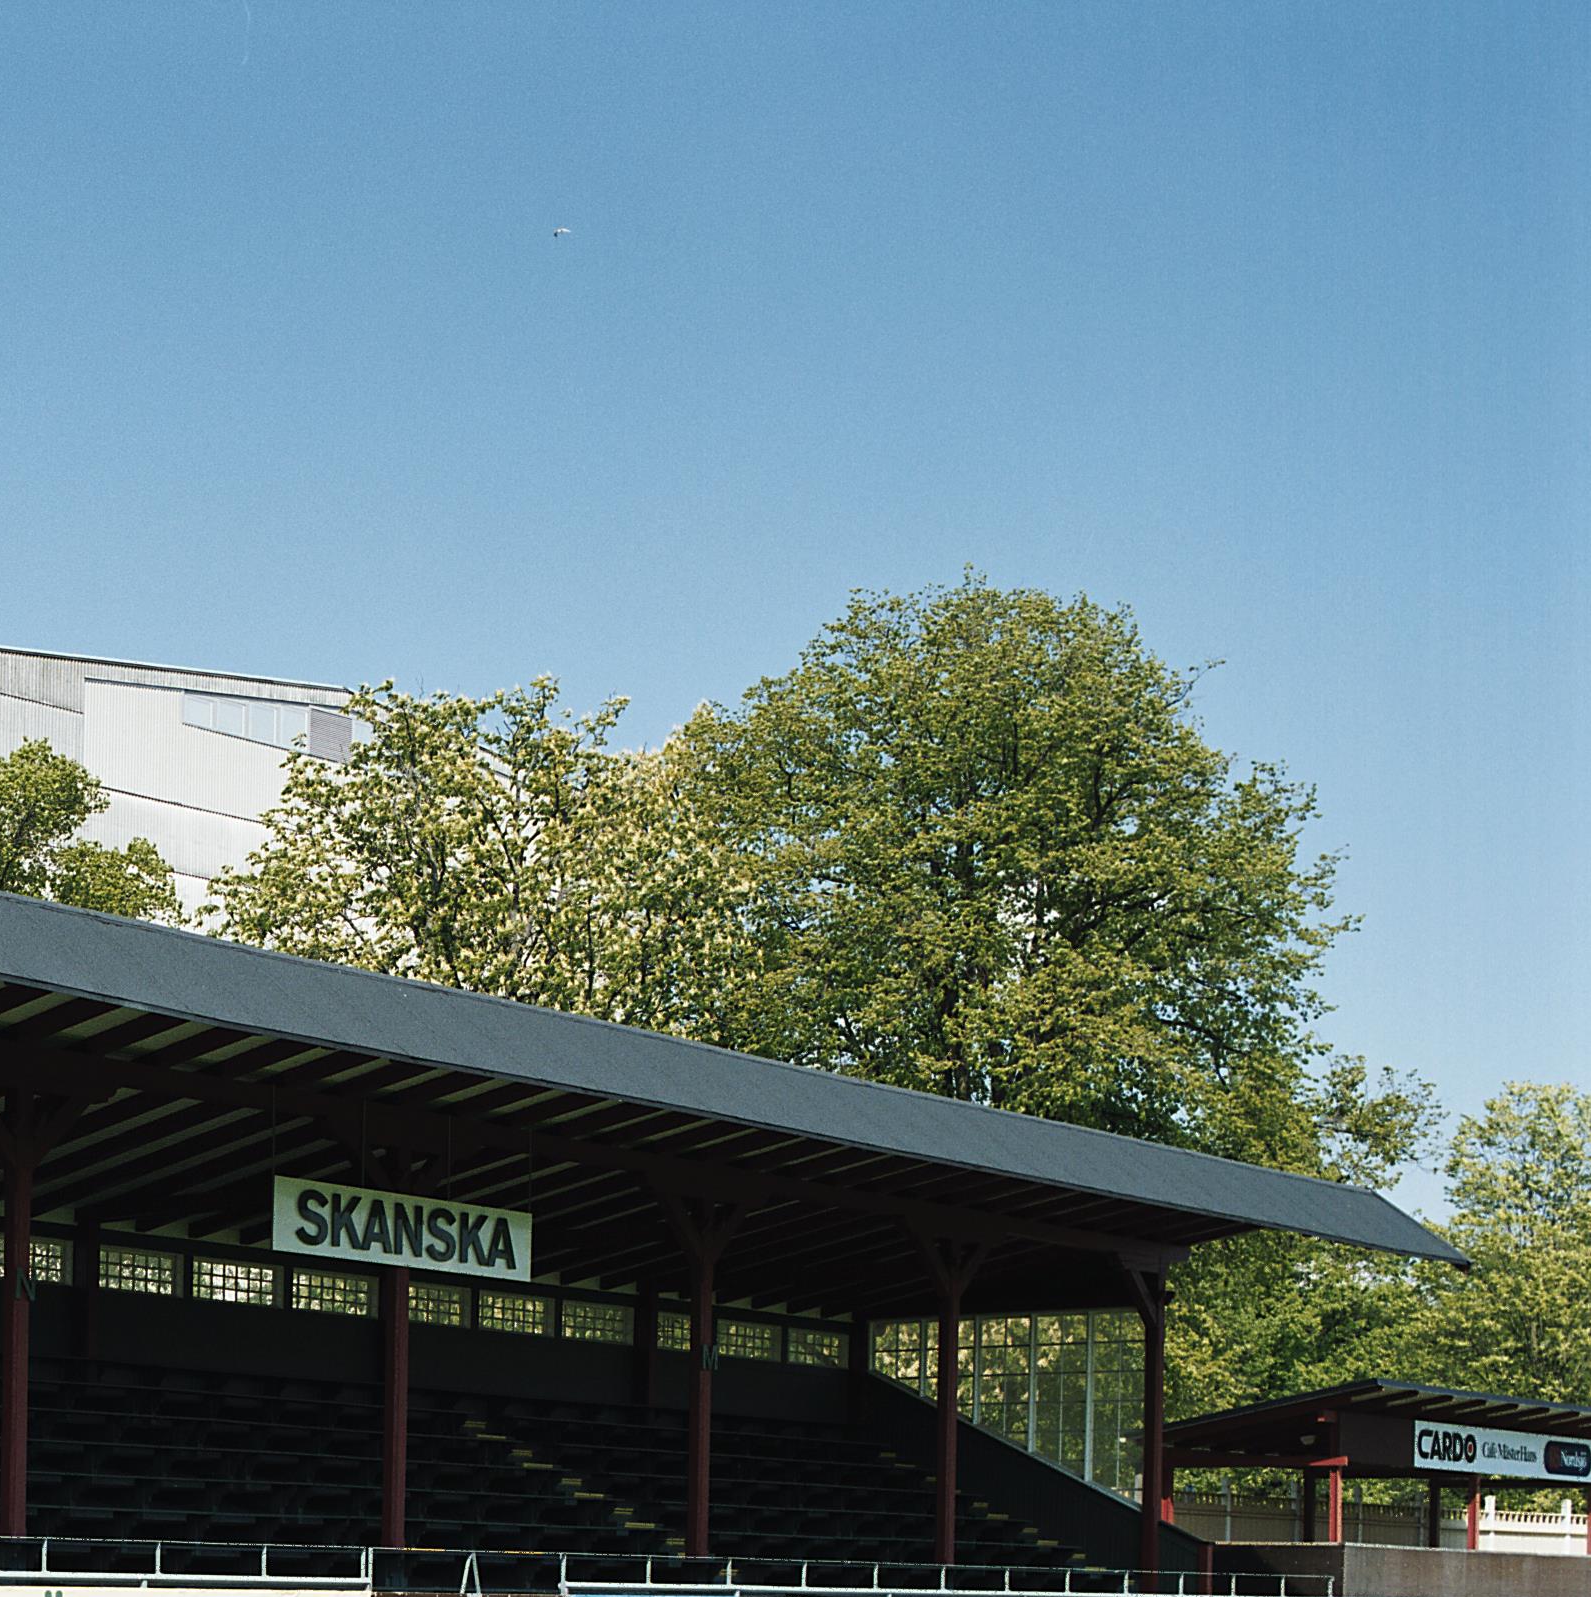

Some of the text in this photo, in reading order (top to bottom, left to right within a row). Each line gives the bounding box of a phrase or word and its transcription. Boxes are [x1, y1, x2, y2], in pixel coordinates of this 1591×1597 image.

[295, 1189, 516, 1270] SKANSKA
[15, 1266, 36, 1301] N
[702, 1344, 719, 1371] M
[1417, 1428, 1477, 1464] CARDO
